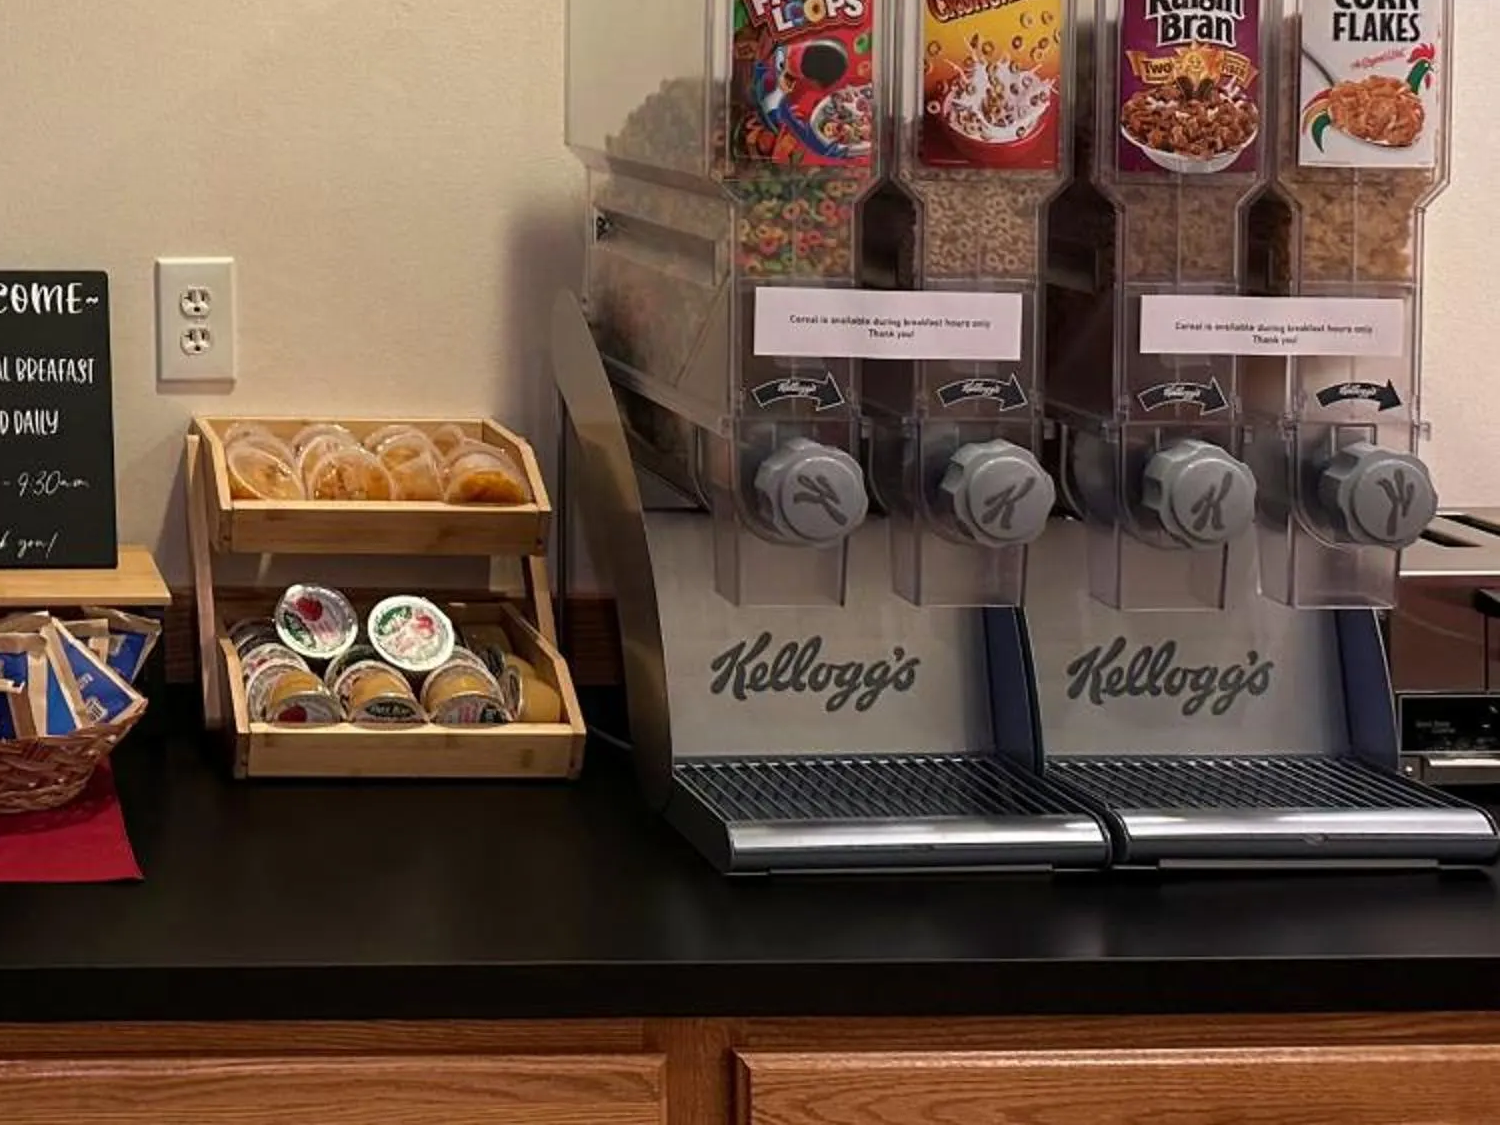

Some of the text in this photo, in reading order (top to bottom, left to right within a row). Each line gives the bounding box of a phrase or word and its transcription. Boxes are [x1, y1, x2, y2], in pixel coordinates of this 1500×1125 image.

[1156, 13, 1237, 46] Bran
[1332, 13, 1421, 43] FLAKES
[13, 409, 60, 436] DAILY
[710, 631, 921, 712] Kellogg's
[1066, 636, 1275, 716] Kellogg's
